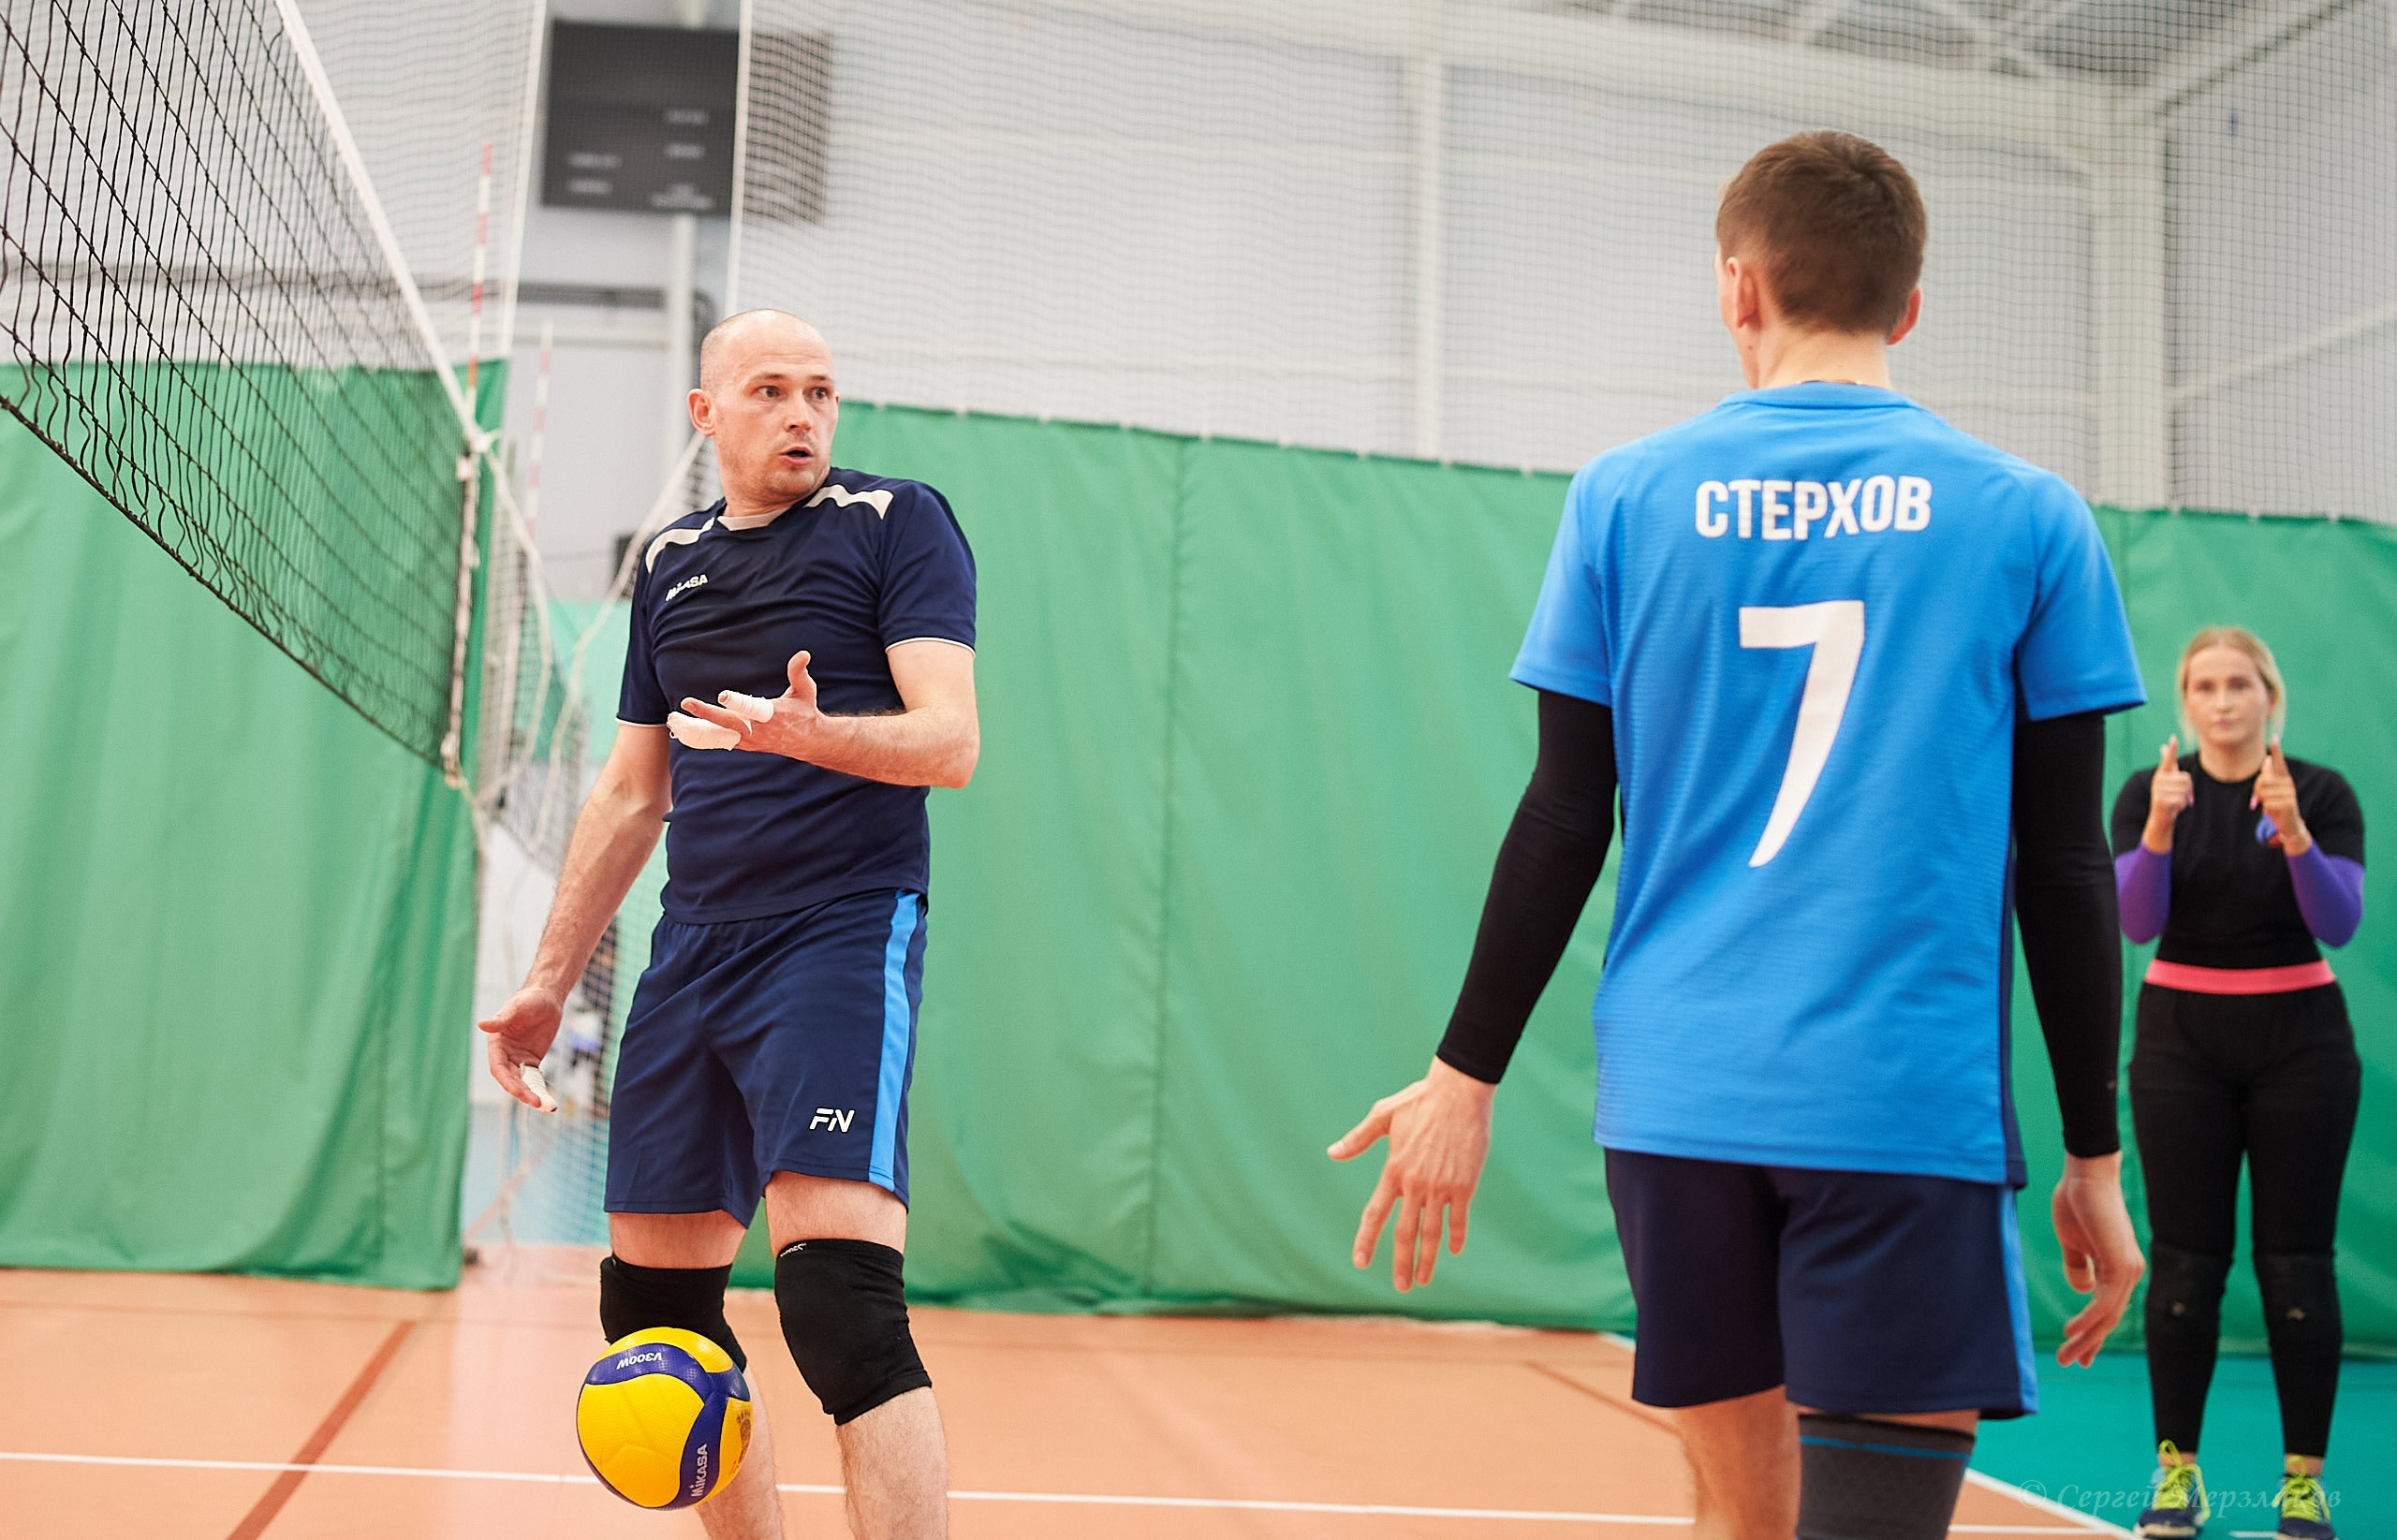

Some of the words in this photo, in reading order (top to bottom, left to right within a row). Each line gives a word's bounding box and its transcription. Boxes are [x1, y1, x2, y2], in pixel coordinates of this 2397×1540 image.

[1695, 476, 1933, 541] СТЕРХОВ
[1738, 599, 1866, 868] 7
[809, 1107, 856, 1133] FN
[615, 1351, 663, 1371] V300W
